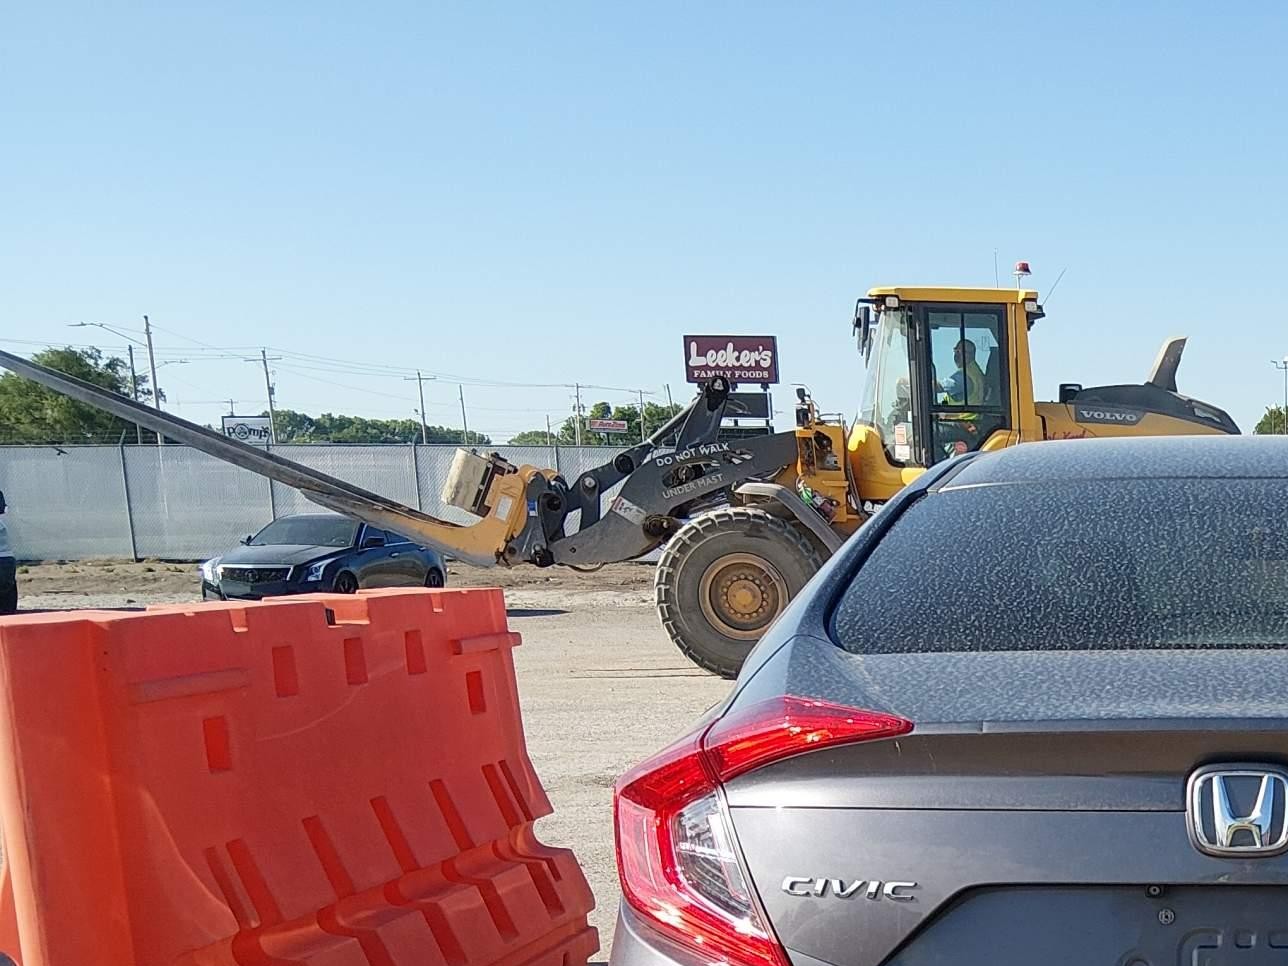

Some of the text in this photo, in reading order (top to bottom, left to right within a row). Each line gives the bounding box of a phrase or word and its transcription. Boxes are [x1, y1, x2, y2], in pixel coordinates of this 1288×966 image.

[689, 341, 772, 368] Leeker's
[693, 370, 732, 378] FAMILY
[1080, 410, 1137, 421] VOLVO
[656, 442, 730, 467] DO NOT WALK
[662, 473, 723, 499] UNDER MAST
[781, 875, 918, 902] CIVIC
